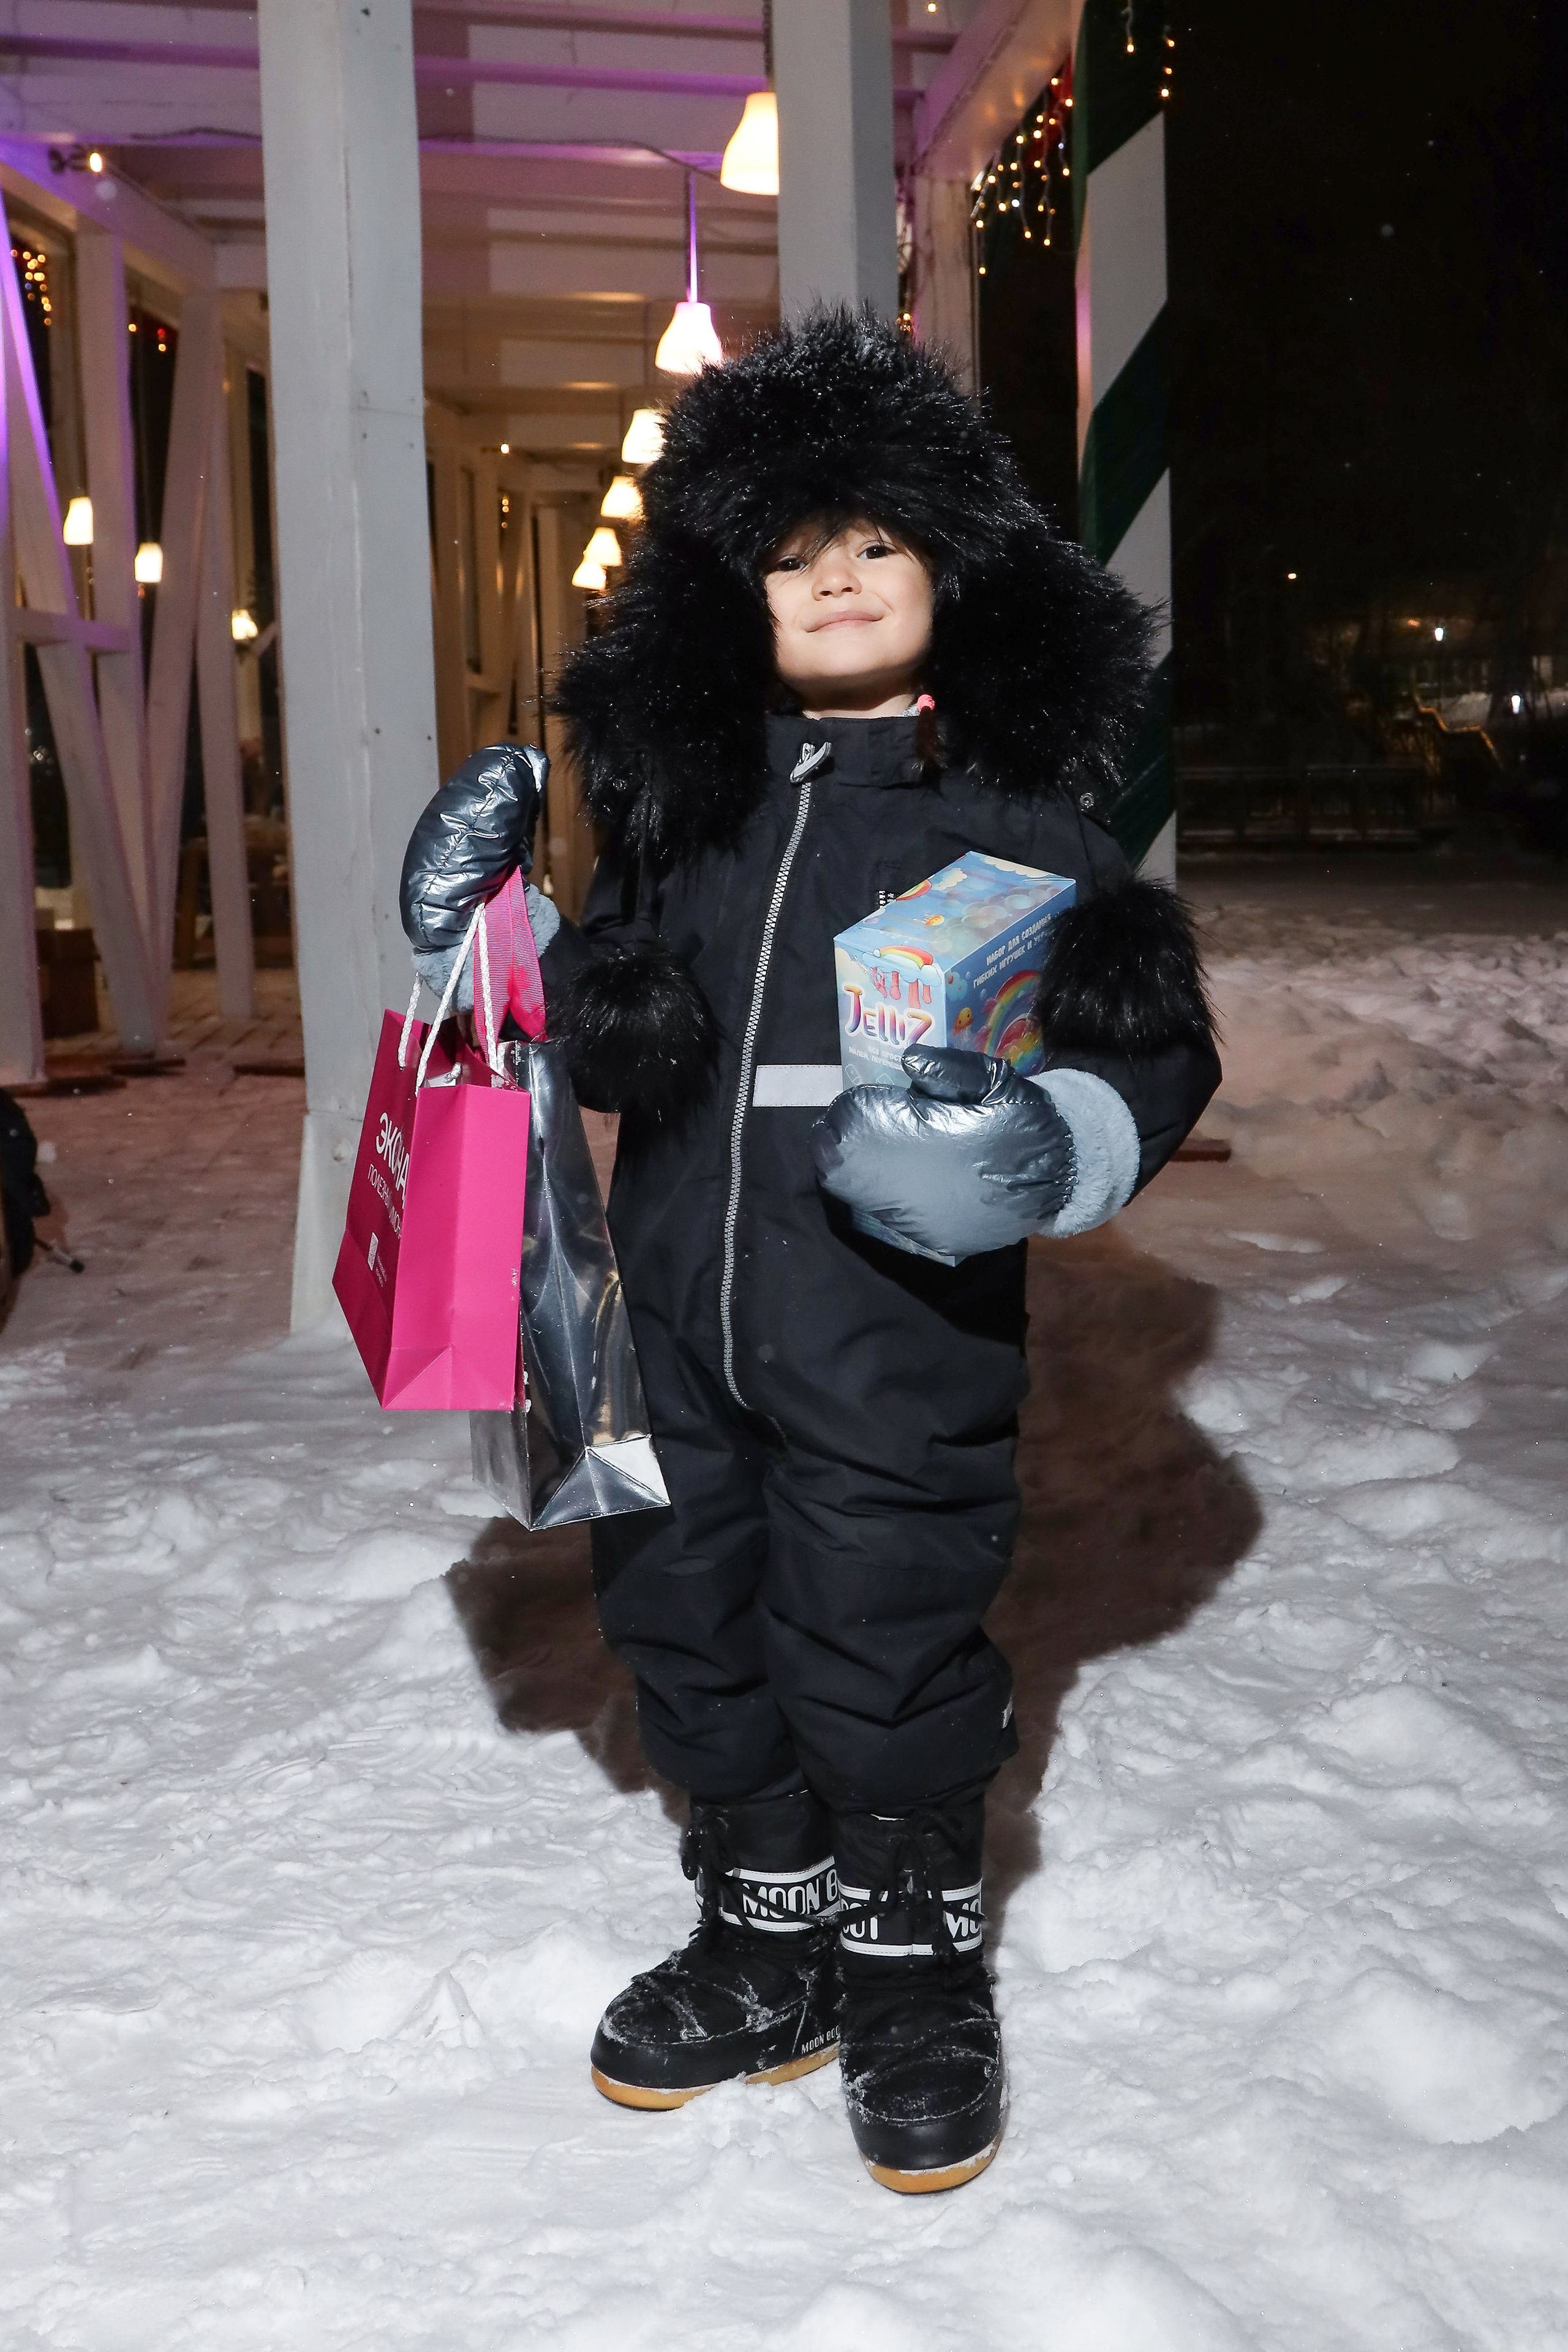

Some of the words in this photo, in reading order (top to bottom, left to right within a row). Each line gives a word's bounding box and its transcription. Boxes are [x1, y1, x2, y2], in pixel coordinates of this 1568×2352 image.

[986, 945, 1006, 965] НАБОР
[1008, 935, 1020, 951] ДЛЯ
[882, 1050, 902, 1063] ПРОСТ
[801, 2034, 824, 2054] MOON
[826, 2025, 840, 2041] BOO
